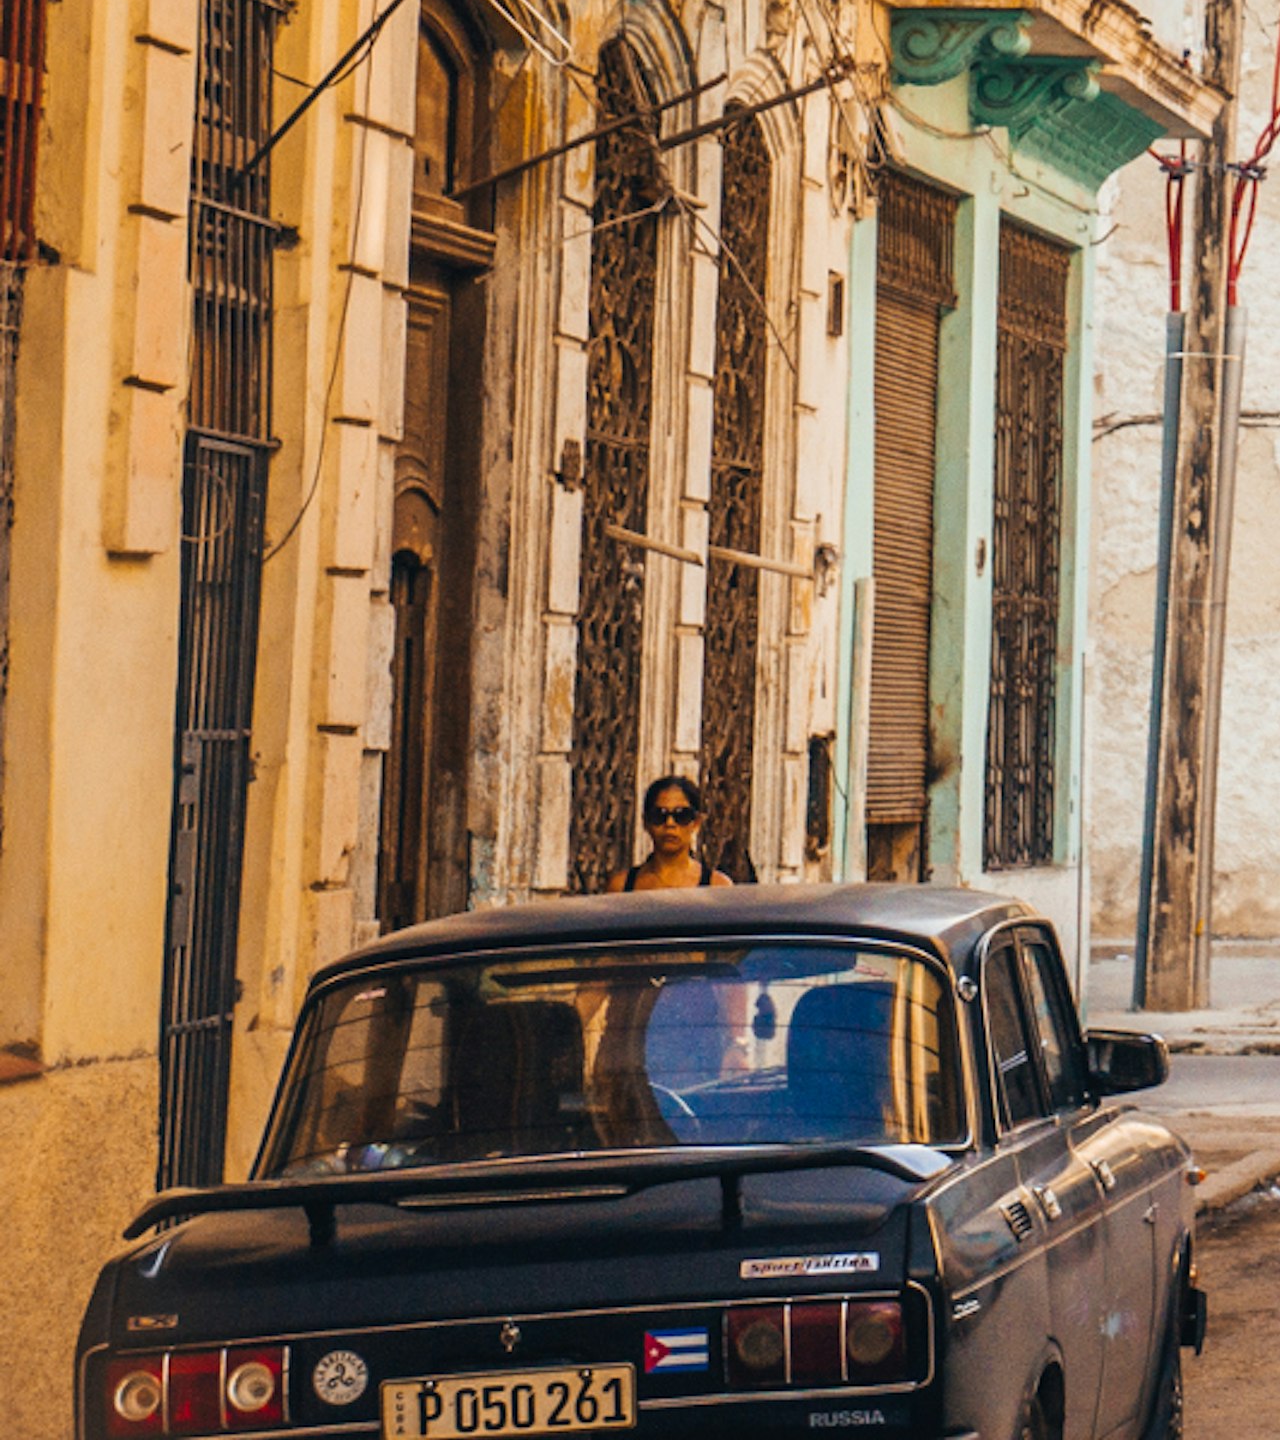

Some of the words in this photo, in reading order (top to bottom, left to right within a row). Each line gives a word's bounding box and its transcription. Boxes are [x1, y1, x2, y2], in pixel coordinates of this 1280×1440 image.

[396, 1392, 404, 1435] CUBA
[418, 1391, 441, 1435] P
[455, 1384, 535, 1433] 050
[547, 1377, 627, 1425] 261
[809, 1410, 885, 1428] RUSSIA
